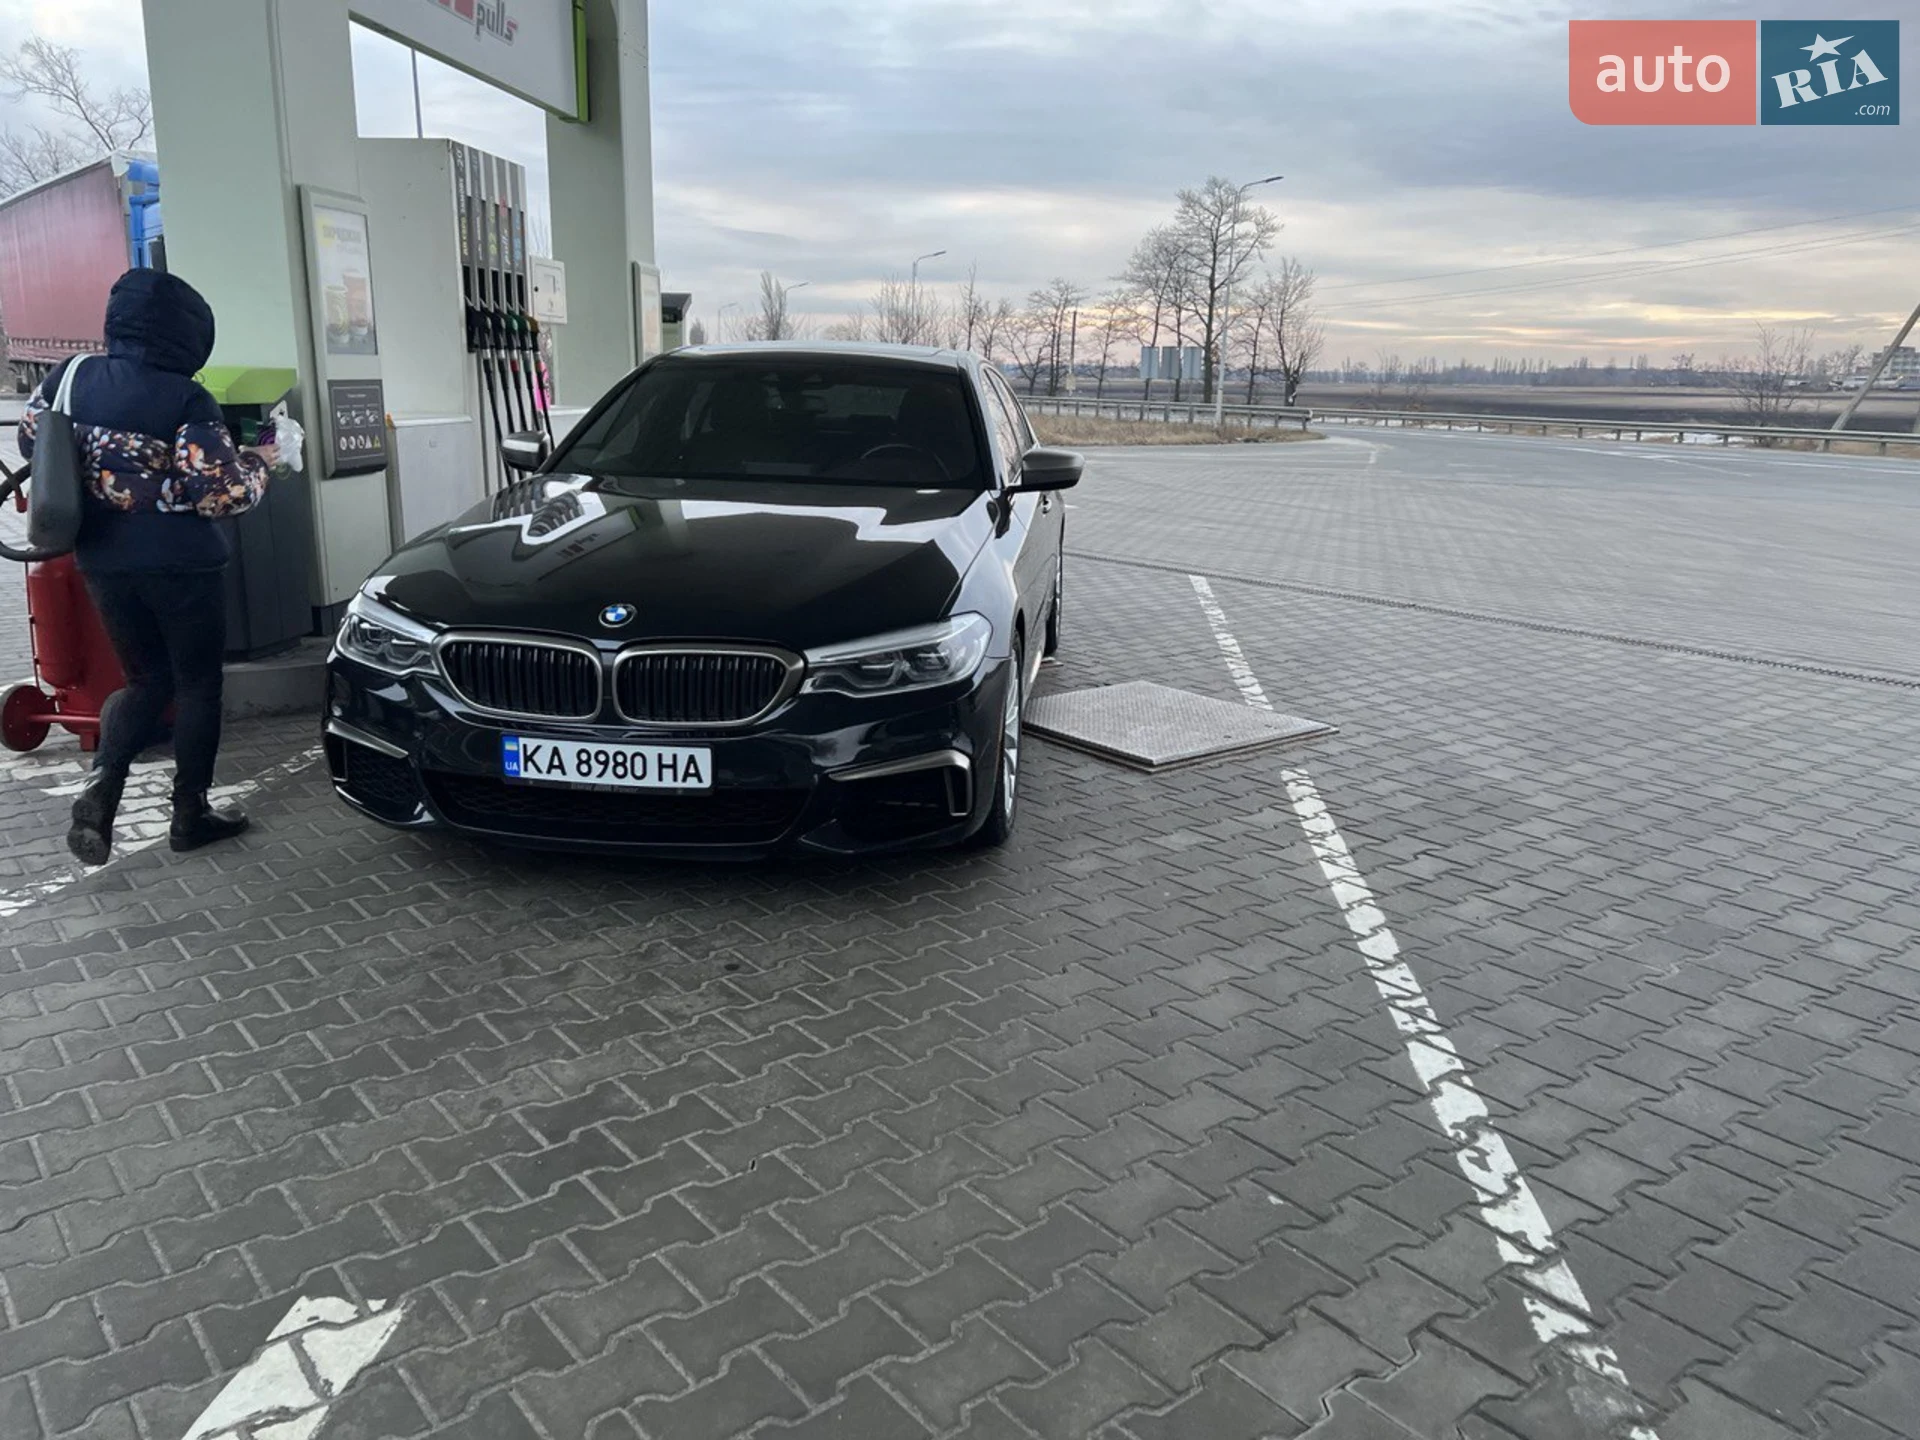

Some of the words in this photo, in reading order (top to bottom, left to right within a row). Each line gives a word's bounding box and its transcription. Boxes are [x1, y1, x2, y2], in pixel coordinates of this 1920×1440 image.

[476, 0, 518, 41] pulls
[505, 761, 519, 771] UA
[522, 743, 567, 776] KA
[575, 748, 648, 780] 8980
[657, 752, 704, 783] HA
